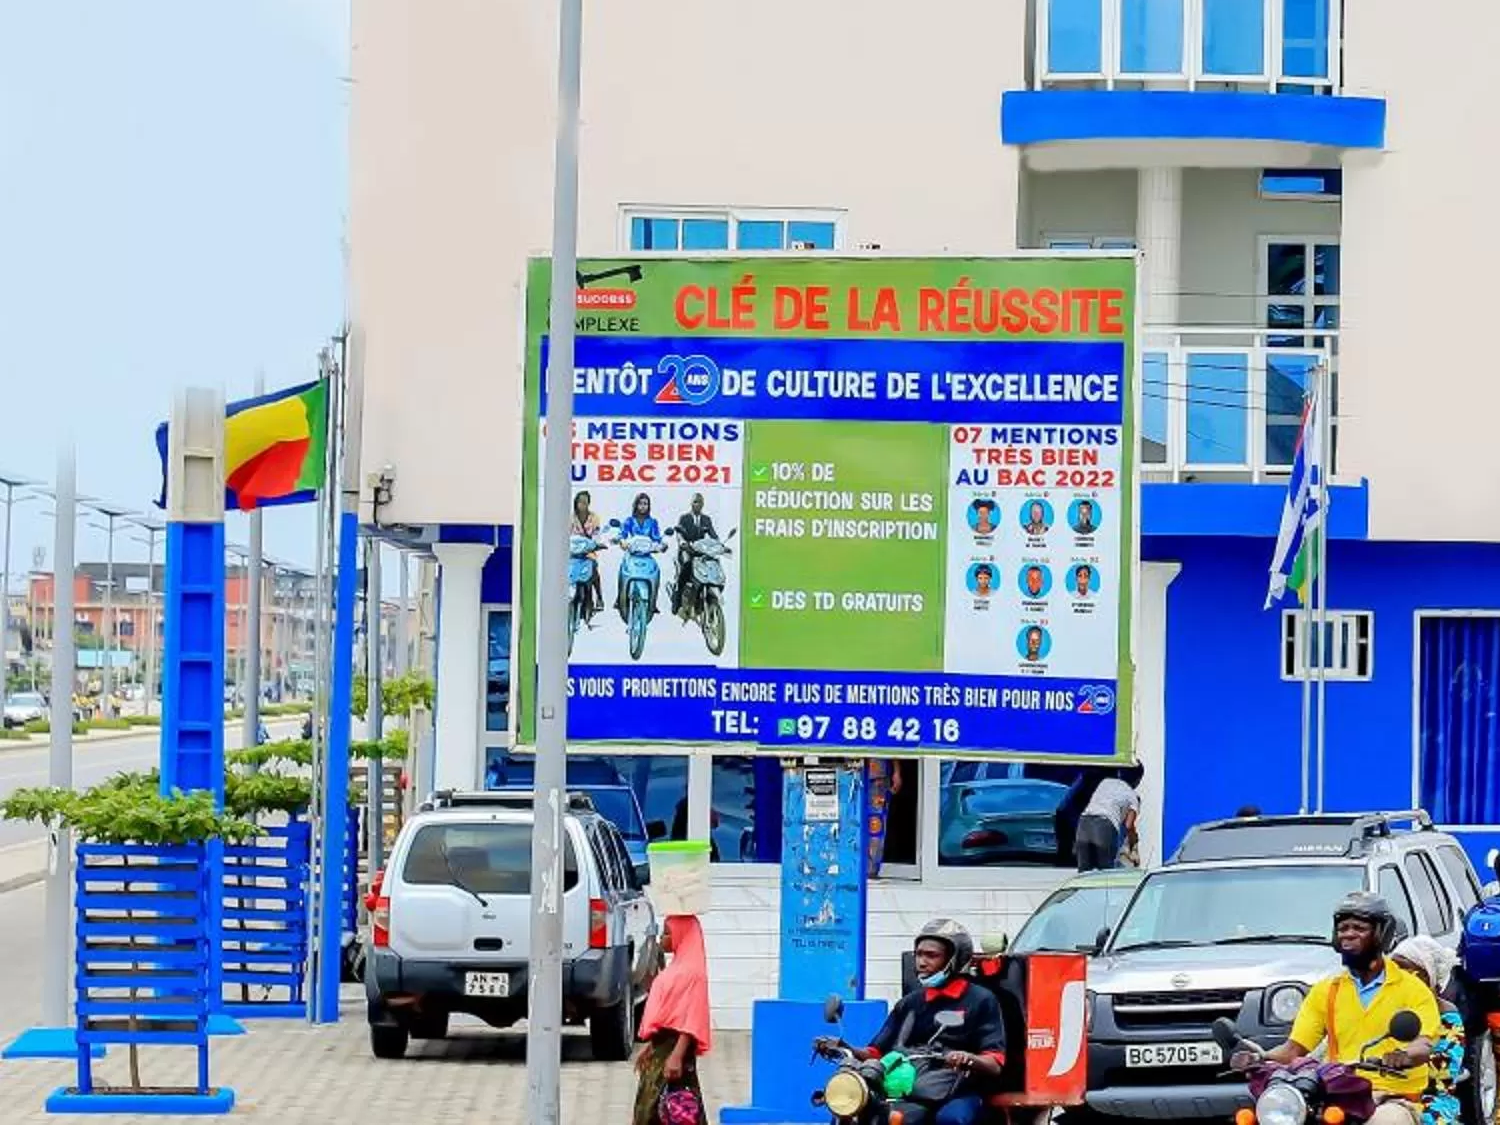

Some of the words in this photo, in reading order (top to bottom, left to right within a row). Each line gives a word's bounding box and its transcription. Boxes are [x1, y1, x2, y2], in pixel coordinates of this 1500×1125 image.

[674, 273, 758, 330] CLÉ
[773, 286, 831, 330] DE
[848, 286, 901, 331] LA
[919, 276, 1124, 334] RÉUSSITE
[547, 317, 641, 332] MPLEXE
[546, 361, 653, 395] ENTÔT
[722, 370, 756, 397] DE
[766, 369, 876, 398] CULTURE
[887, 372, 920, 399] DE
[932, 371, 1119, 402] L'EXCELLENCE
[587, 422, 739, 441] MENTIONS
[953, 427, 982, 444] 07
[991, 428, 1118, 446] MENTIONS
[648, 444, 715, 461] BIEN
[972, 444, 1032, 465] TRÈS
[1041, 448, 1098, 466] BIEN
[597, 465, 656, 482] BAC
[667, 466, 731, 484] 2021
[772, 463, 805, 481] 10%
[812, 463, 835, 481] DE
[956, 469, 988, 486] AU
[997, 470, 1045, 486] BAC
[1056, 470, 1115, 487] 2022
[755, 488, 853, 509] RÉDUCTION
[860, 493, 893, 511] SUR
[900, 493, 933, 512] LES
[755, 519, 805, 536] FRAIS
[812, 519, 937, 539] D'INSCRIPTION
[772, 591, 806, 609] DES
[814, 592, 835, 609] TD
[842, 592, 923, 611] GRATUITS
[579, 677, 615, 697] VOUS
[622, 677, 716, 698] PROMETTONS
[721, 681, 776, 702] ENCORE
[784, 682, 820, 703] PLUS
[824, 684, 842, 704] DE
[847, 684, 919, 706] MENTIONS
[924, 683, 960, 707] TRÈS
[964, 687, 997, 708] BIEN
[1002, 689, 1040, 710] POUR
[1044, 691, 1074, 711] NOS
[711, 710, 758, 734] TEL:
[797, 715, 830, 739] 97
[842, 716, 876, 740] 88
[887, 718, 920, 741] 42
[932, 719, 960, 741] 16
[1129, 1048, 1152, 1064] BC
[1156, 1046, 1198, 1063] 5705
